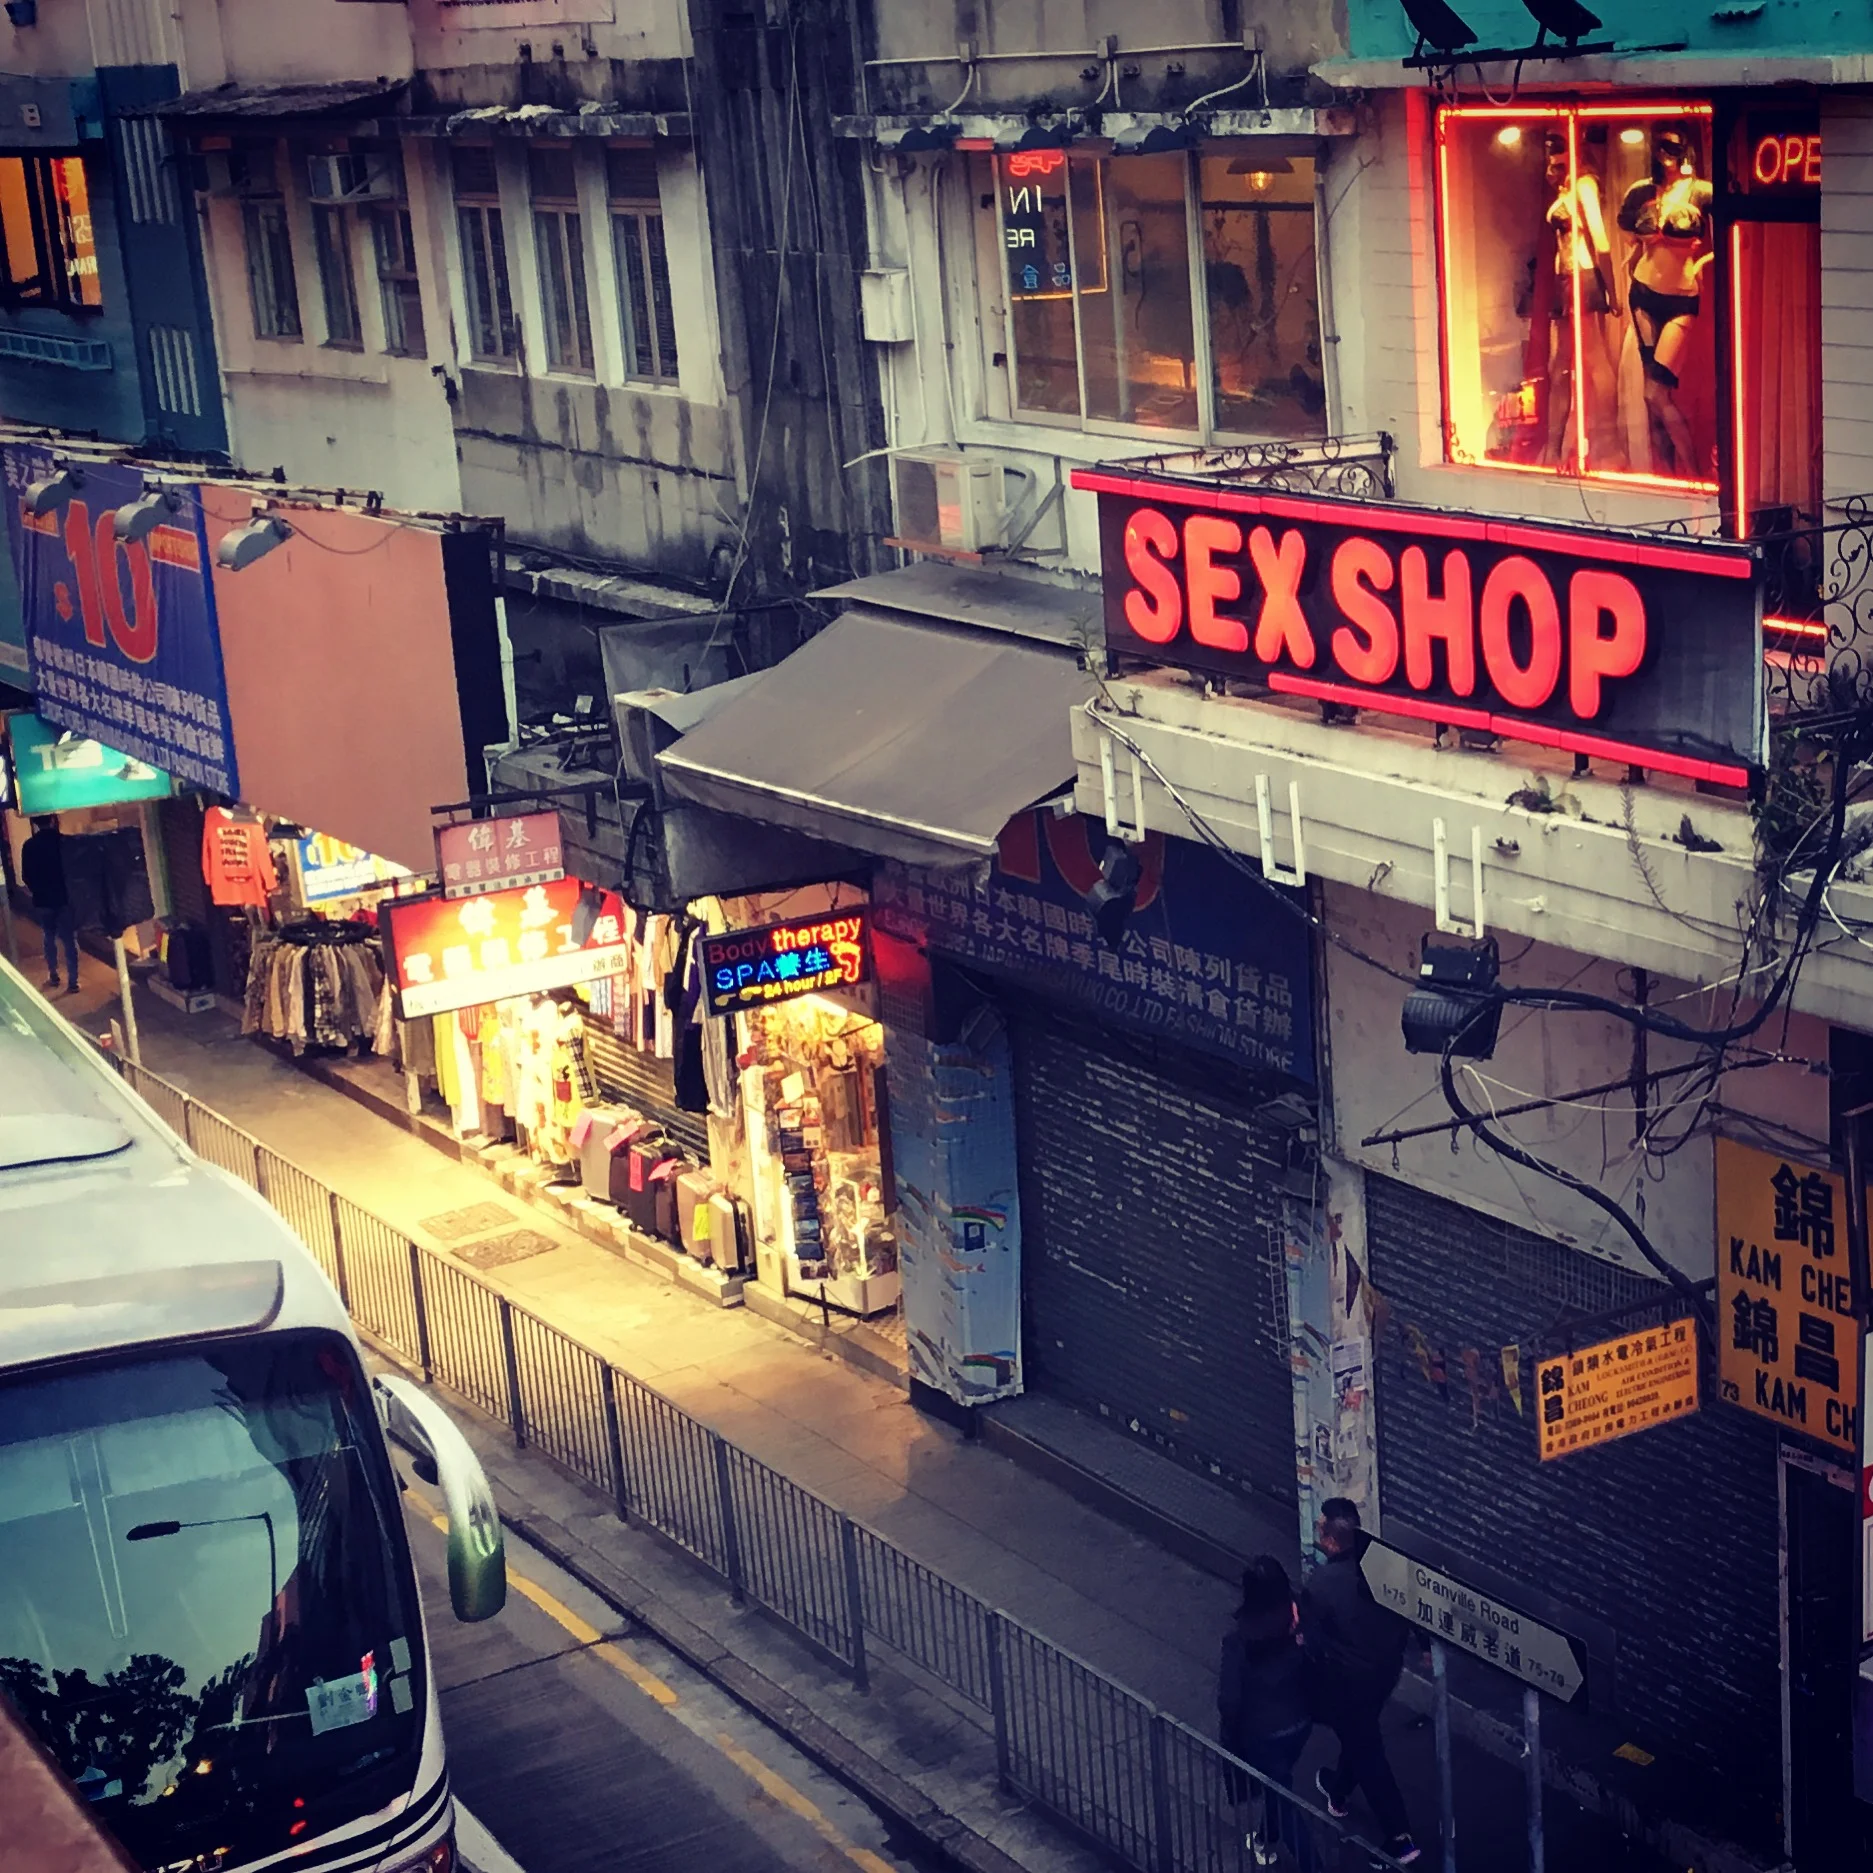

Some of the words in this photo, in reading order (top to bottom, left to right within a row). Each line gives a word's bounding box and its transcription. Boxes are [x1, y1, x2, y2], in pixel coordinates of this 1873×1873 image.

[1124, 508, 1316, 669] SEX
[1331, 536, 1647, 719] SHOP
[708, 939, 767, 965] Body
[772, 917, 861, 951] therapy
[762, 983, 781, 999] 24
[783, 976, 814, 995] hour
[1241, 1034, 1294, 1072] STORE
[1730, 1236, 1782, 1292] KAM
[1567, 1380, 1591, 1398] KAM
[1568, 1391, 1609, 1414] CHEONG
[1755, 1368, 1807, 1424] KAM
[1415, 1568, 1477, 1613] Granville
[1480, 1603, 1520, 1635] Road
[1417, 1597, 1522, 1673] 加連威老道
